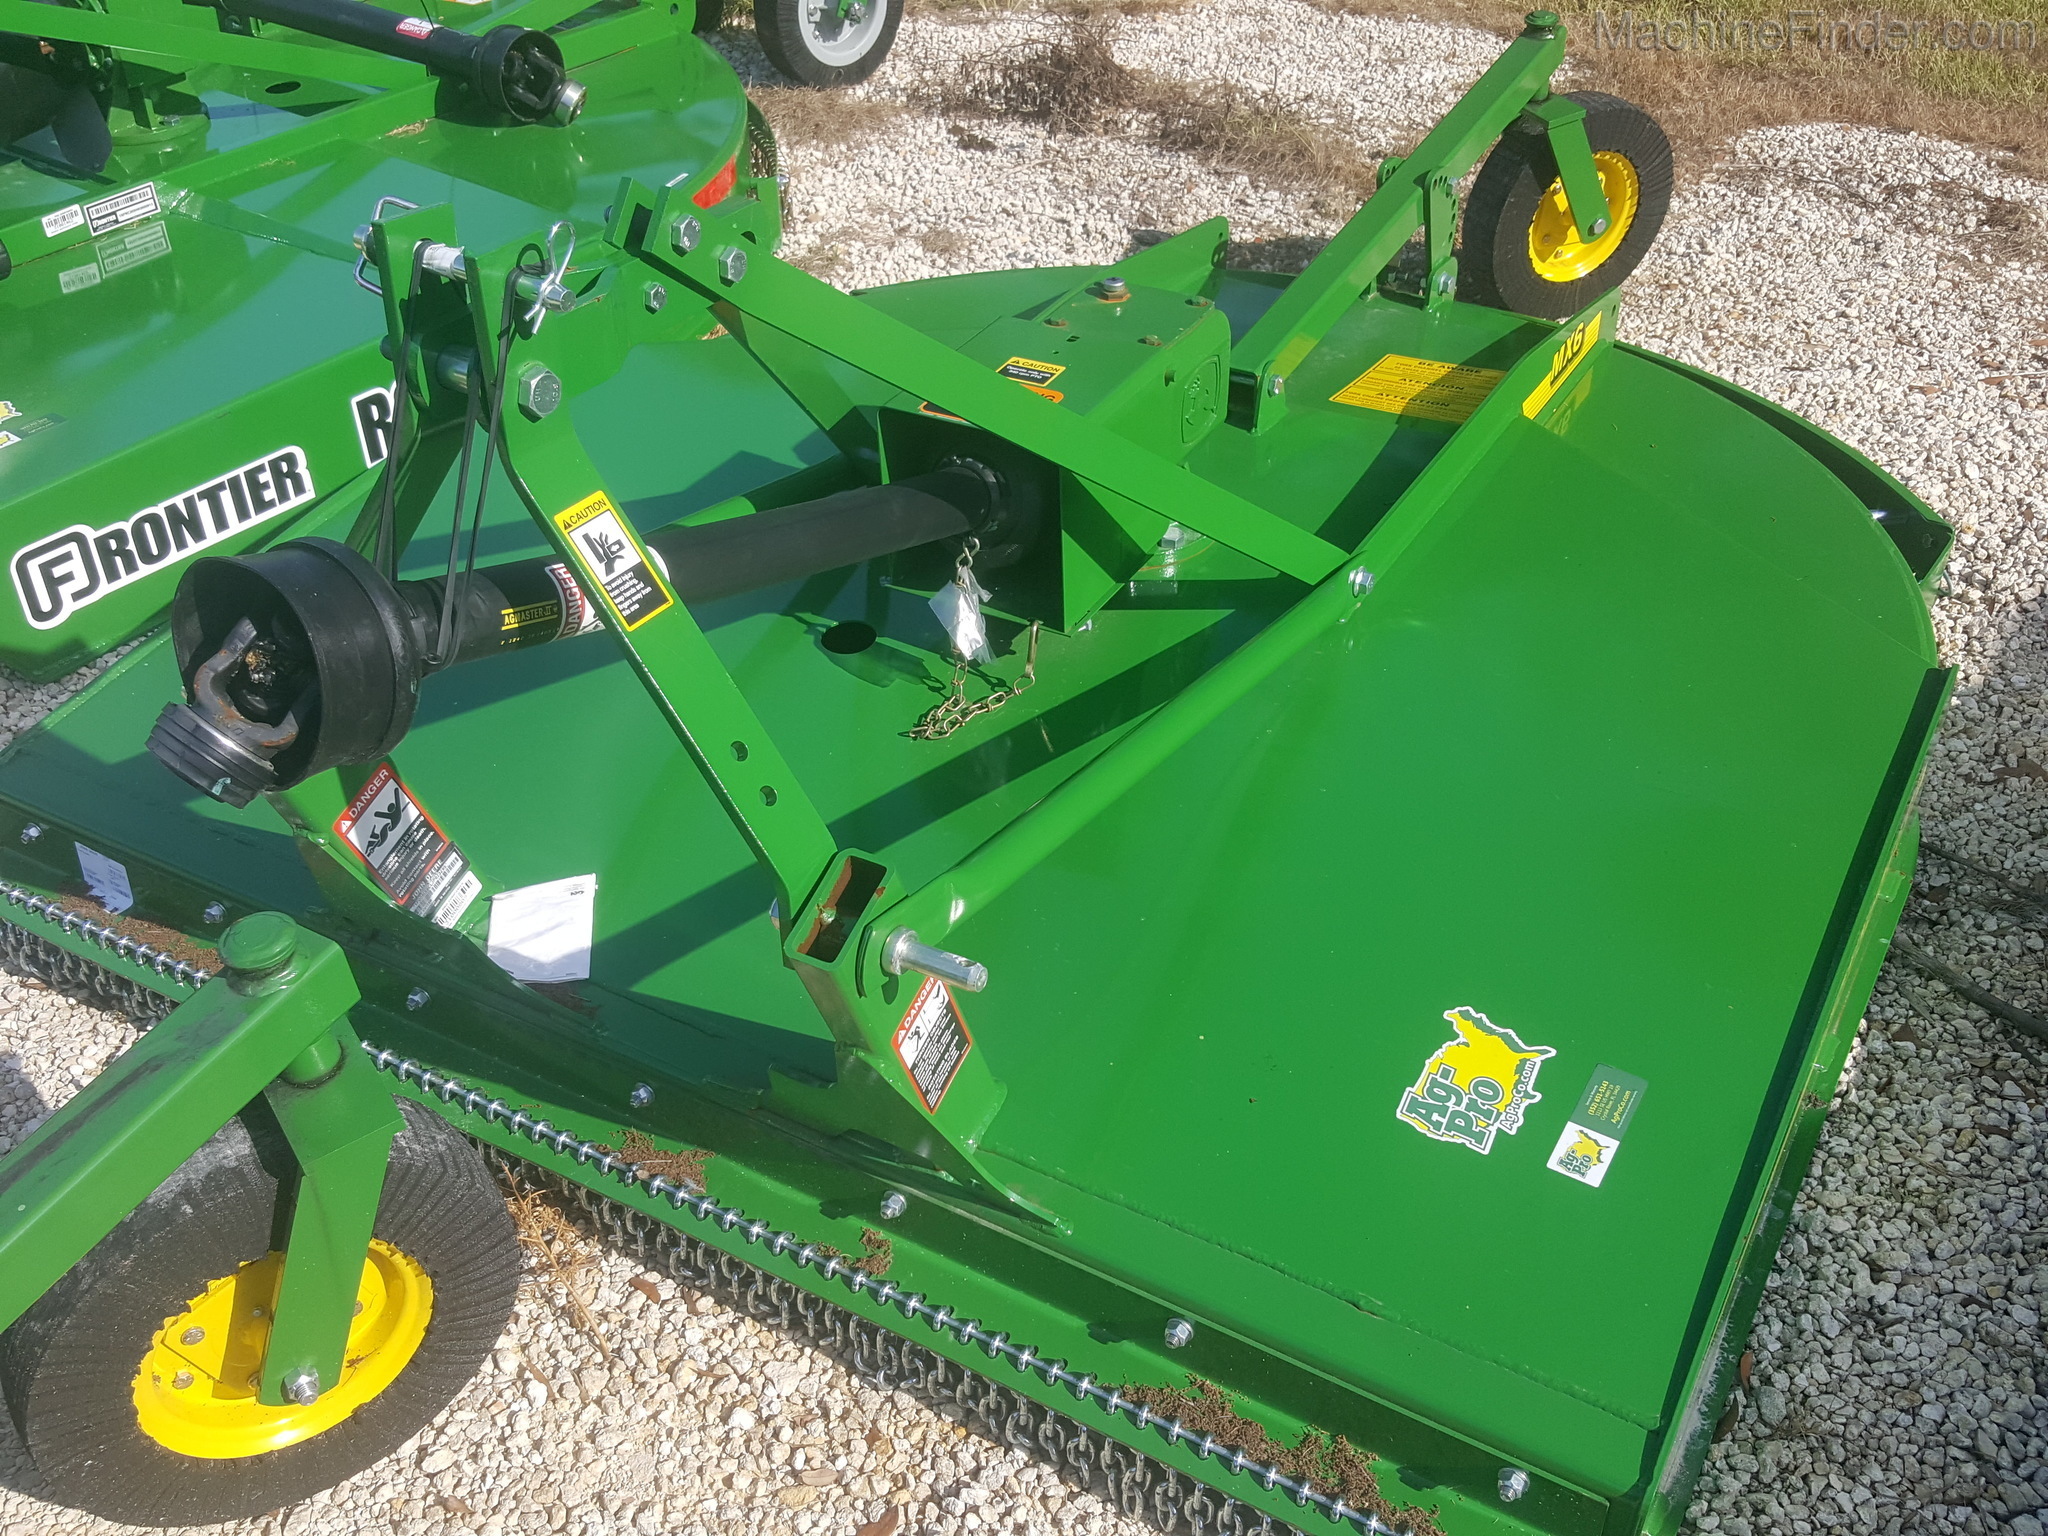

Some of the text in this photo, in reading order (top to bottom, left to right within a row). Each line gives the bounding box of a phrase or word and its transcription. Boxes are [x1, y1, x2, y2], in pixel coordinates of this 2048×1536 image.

[1022, 361, 1061, 373] CAUTION
[1439, 363, 1483, 374] AWARE
[1550, 322, 1585, 383] MX6
[1375, 392, 1451, 407] ATTENTION
[569, 498, 607, 525] CAUTION
[16, 452, 307, 622] FRONTIER
[610, 577, 623, 588] avoid
[621, 570, 634, 582] injury
[623, 587, 636, 597] hands
[641, 586, 651, 594] from
[555, 567, 583, 636] DANGER
[348, 768, 389, 818] DANGER
[378, 840, 405, 874] Entanglement
[407, 815, 424, 835] rotating
[384, 862, 399, 880] serious
[398, 848, 410, 863] injury
[413, 825, 426, 842] death.
[390, 873, 401, 887] Keep
[405, 849, 419, 867] shields
[422, 829, 434, 845] place.
[381, 856, 398, 877] driveline
[395, 848, 430, 894] Avoid contact with
[398, 862, 425, 897] rotating parts.
[409, 880, 426, 899] JOHN
[424, 859, 443, 880] DEERE
[1402, 1064, 1466, 1135] Ag-
[1443, 1077, 1503, 1149] Pro
[1500, 1059, 1536, 1130] AgProCo.com
[1611, 1090, 1632, 1124] AgProCo.com
[1559, 1149, 1579, 1172] Ag-
[1572, 1154, 1593, 1178] Pro
